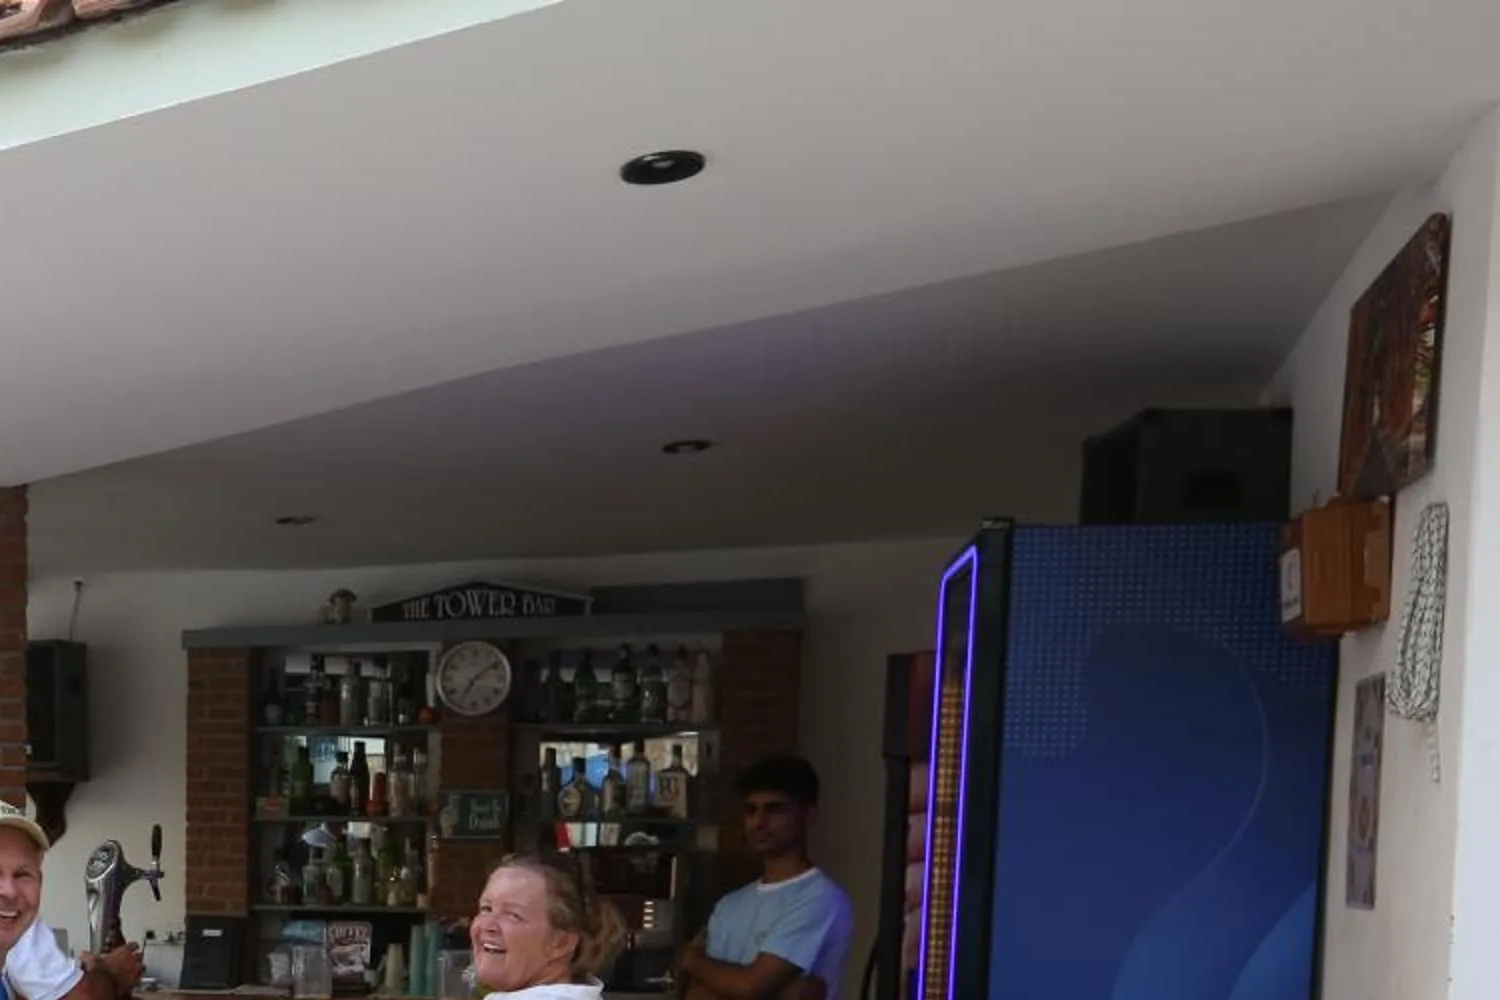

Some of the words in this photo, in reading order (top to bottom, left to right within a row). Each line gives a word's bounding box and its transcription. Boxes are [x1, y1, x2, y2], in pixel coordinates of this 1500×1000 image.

[402, 598, 430, 619] THE
[433, 588, 516, 618] TOWER
[521, 593, 555, 615] BAR
